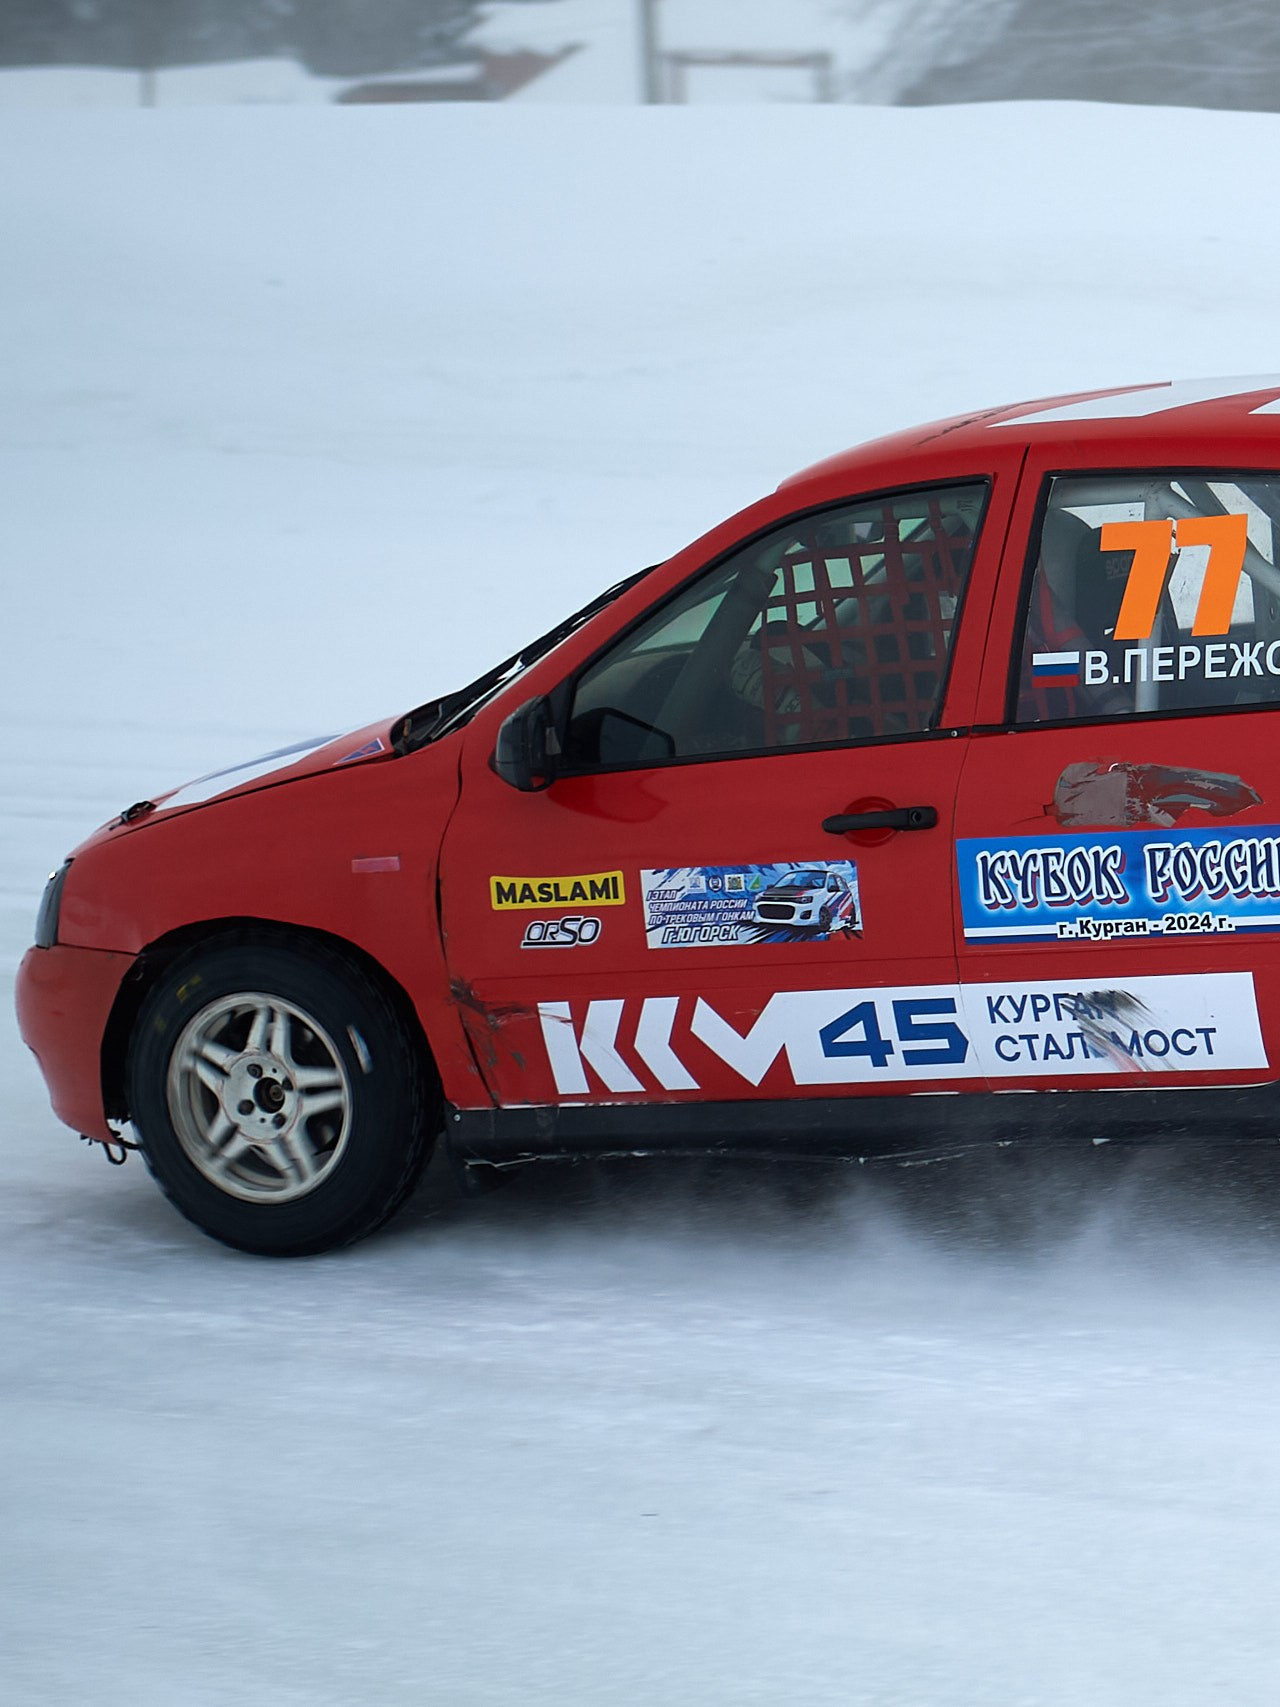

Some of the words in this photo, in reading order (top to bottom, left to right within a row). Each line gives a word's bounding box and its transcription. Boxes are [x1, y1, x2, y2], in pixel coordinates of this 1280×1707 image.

[1100, 513, 1248, 641] 77
[977, 846, 1125, 908] КУБОК
[496, 876, 620, 904] MASLAMI
[650, 901, 708, 912] ЧЕМПИОНАТА
[710, 899, 748, 909] РОССИИ
[716, 911, 755, 922] ГОНКАМ
[1079, 919, 1148, 938] Курган
[1165, 915, 1212, 932] 2024
